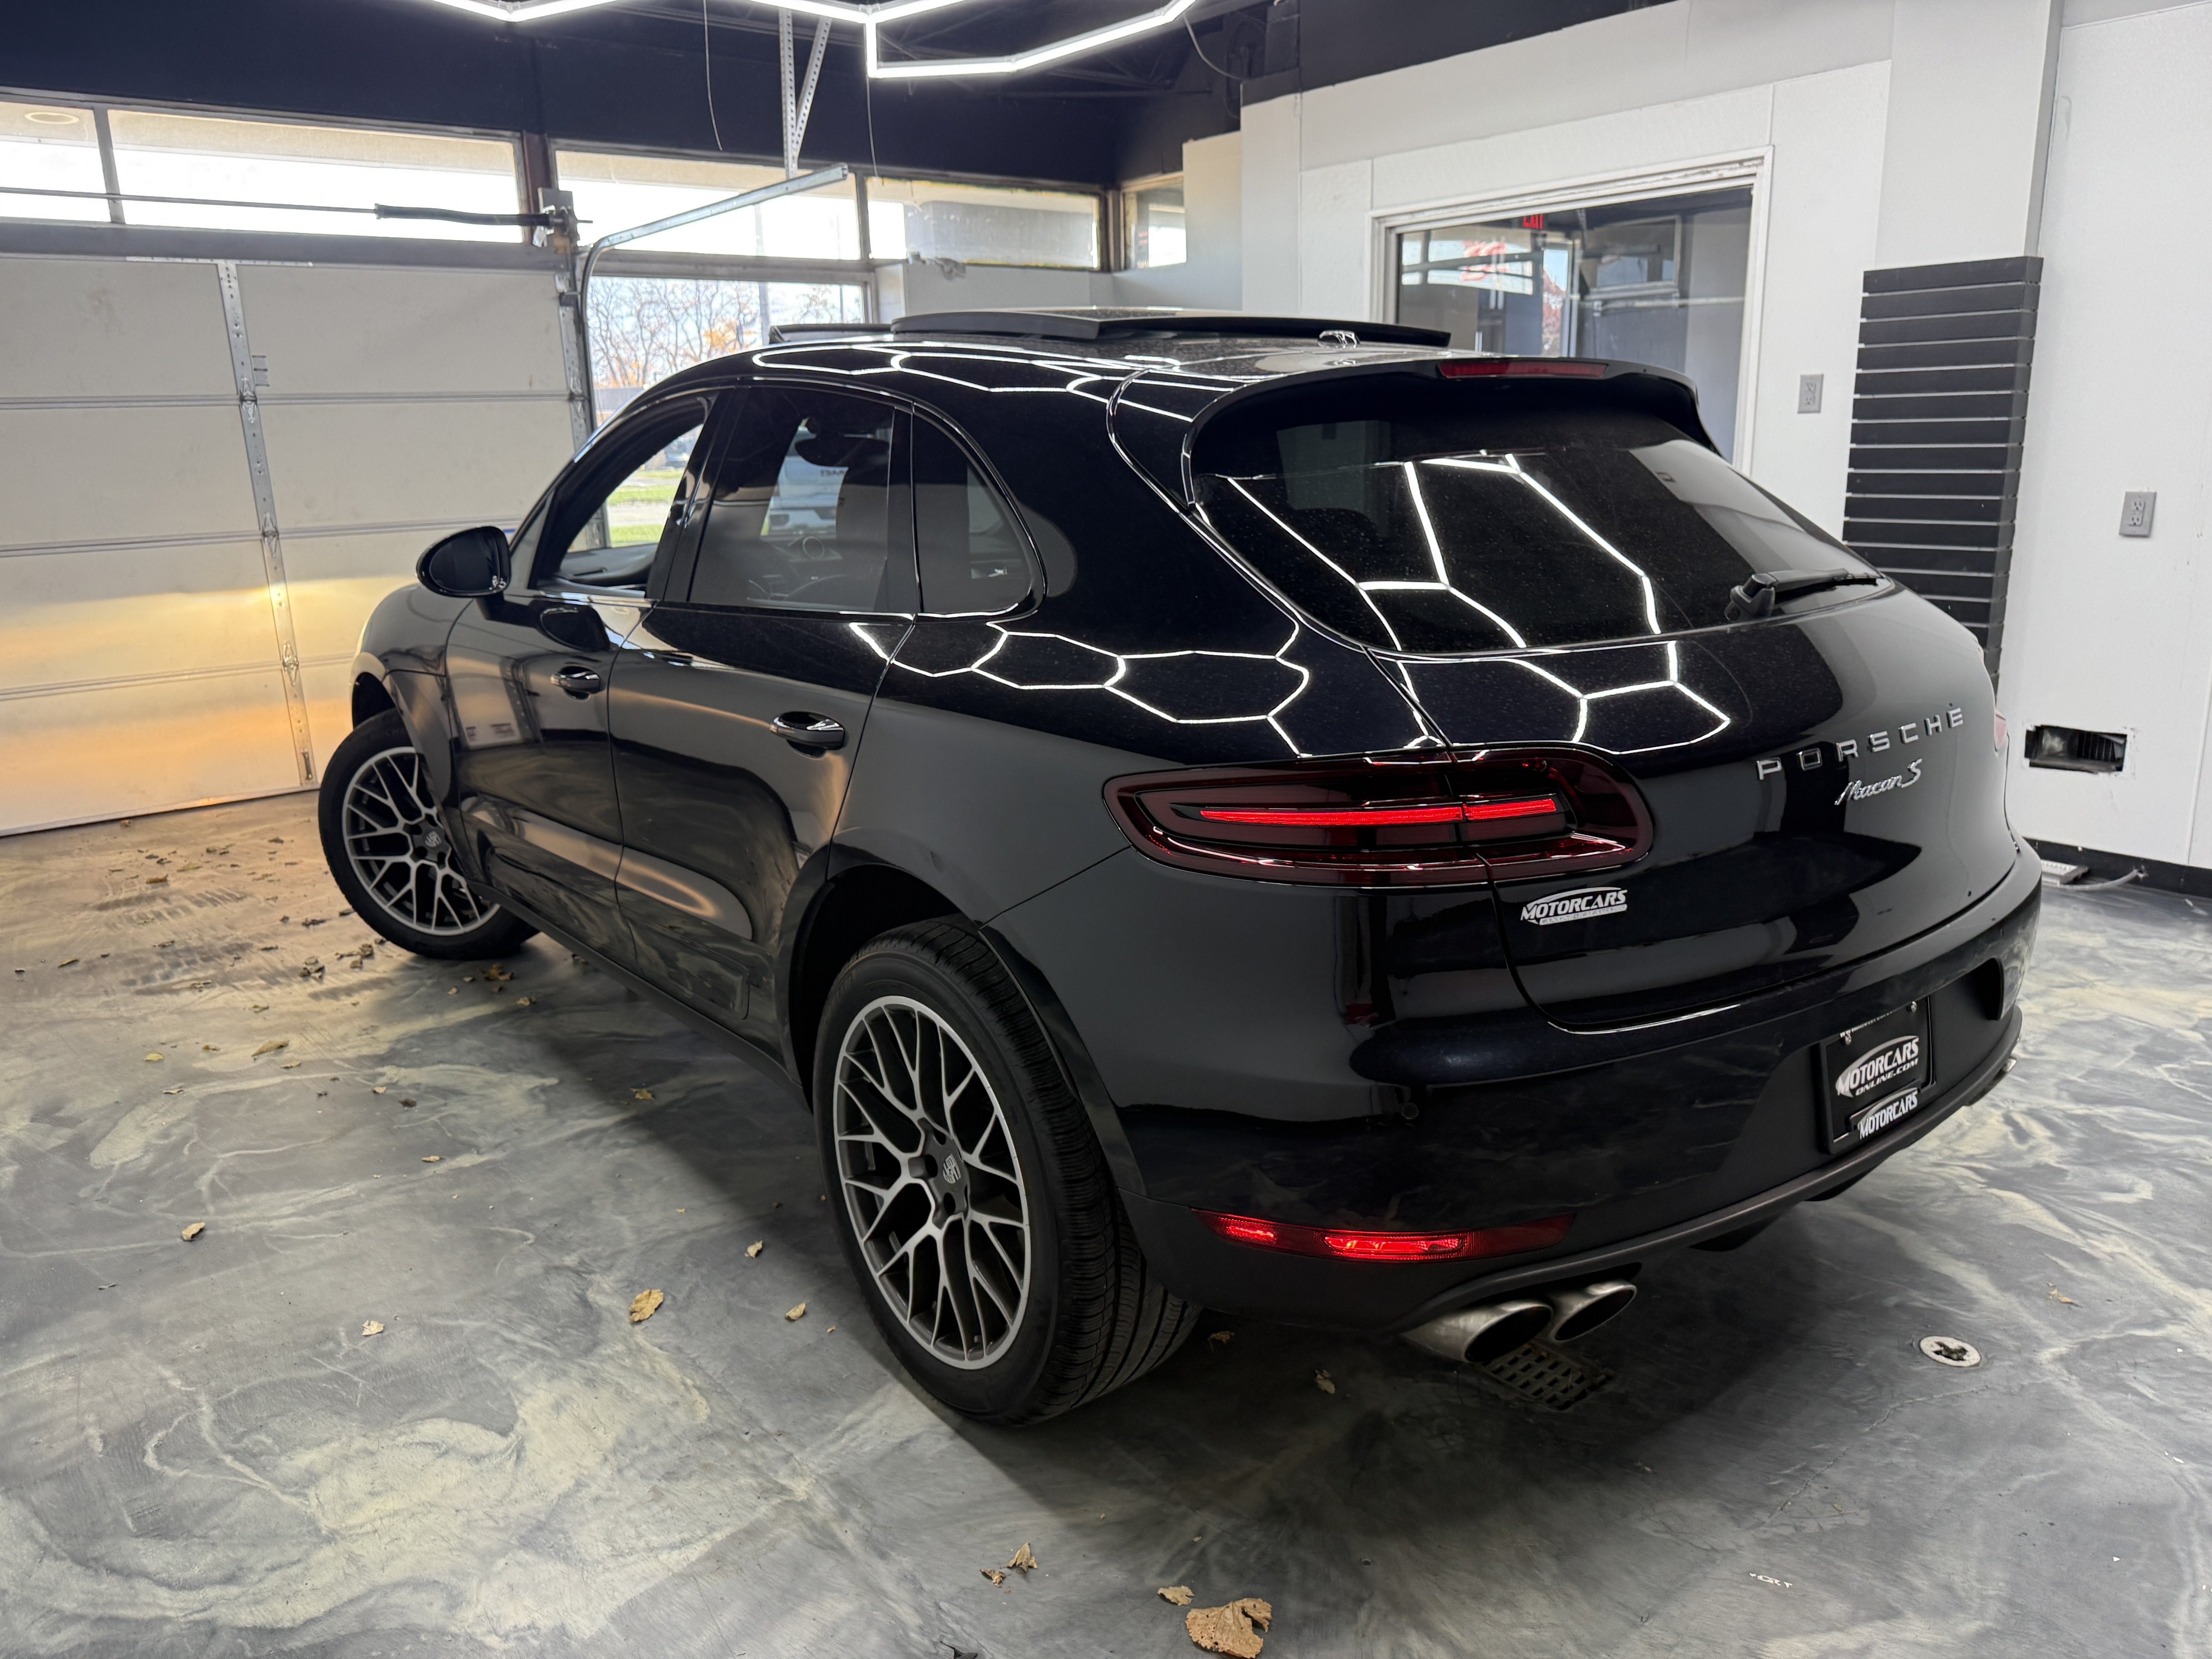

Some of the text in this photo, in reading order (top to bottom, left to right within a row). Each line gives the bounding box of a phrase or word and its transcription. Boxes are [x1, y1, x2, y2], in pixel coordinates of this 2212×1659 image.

[1756, 707, 1963, 780] PORSCHE
[1834, 758, 1923, 805] Macan S
[1520, 889, 1628, 921] MOTORCARS
[1837, 1037, 1919, 1097] MOTORCARS
[1855, 1058, 1918, 1096] ONLINE.COM
[1858, 1090, 1918, 1140] MOTORCARS
